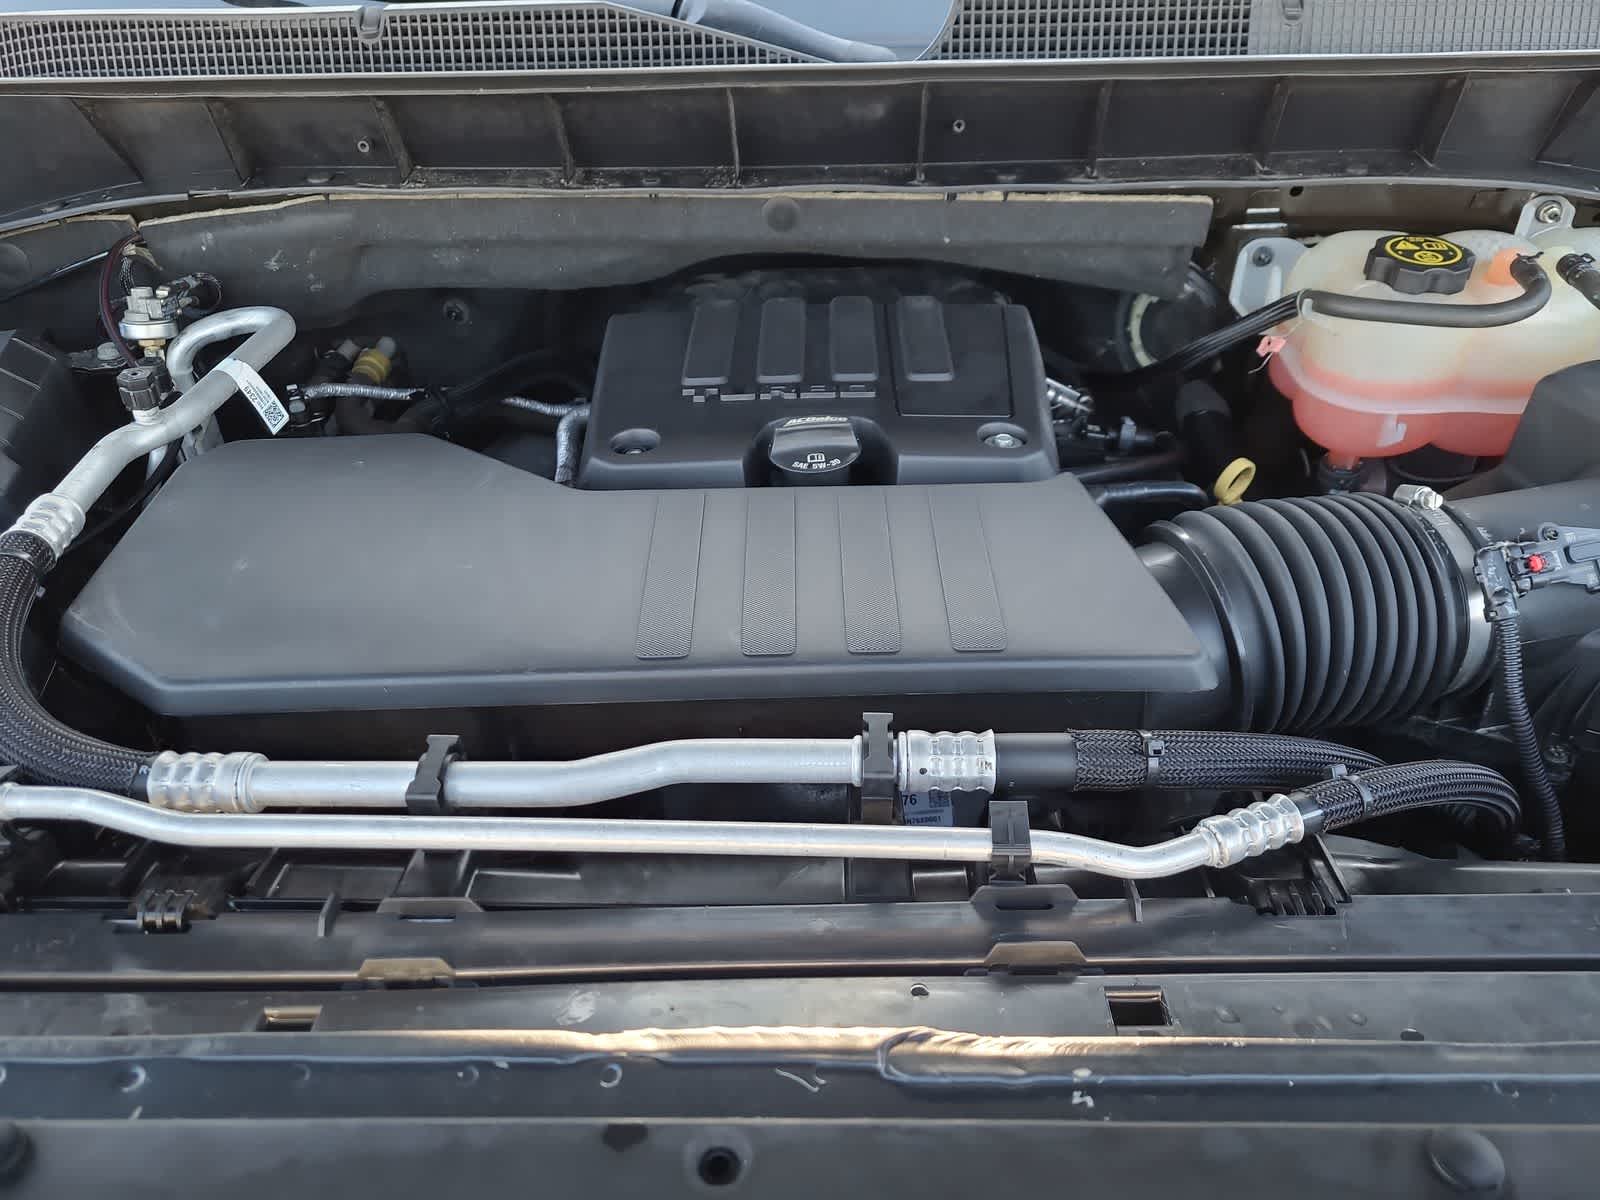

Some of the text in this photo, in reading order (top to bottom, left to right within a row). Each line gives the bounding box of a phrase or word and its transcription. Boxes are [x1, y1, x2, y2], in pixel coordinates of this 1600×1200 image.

[783, 415, 849, 427] ACDelco
[791, 458, 841, 470] SAE 5W-30
